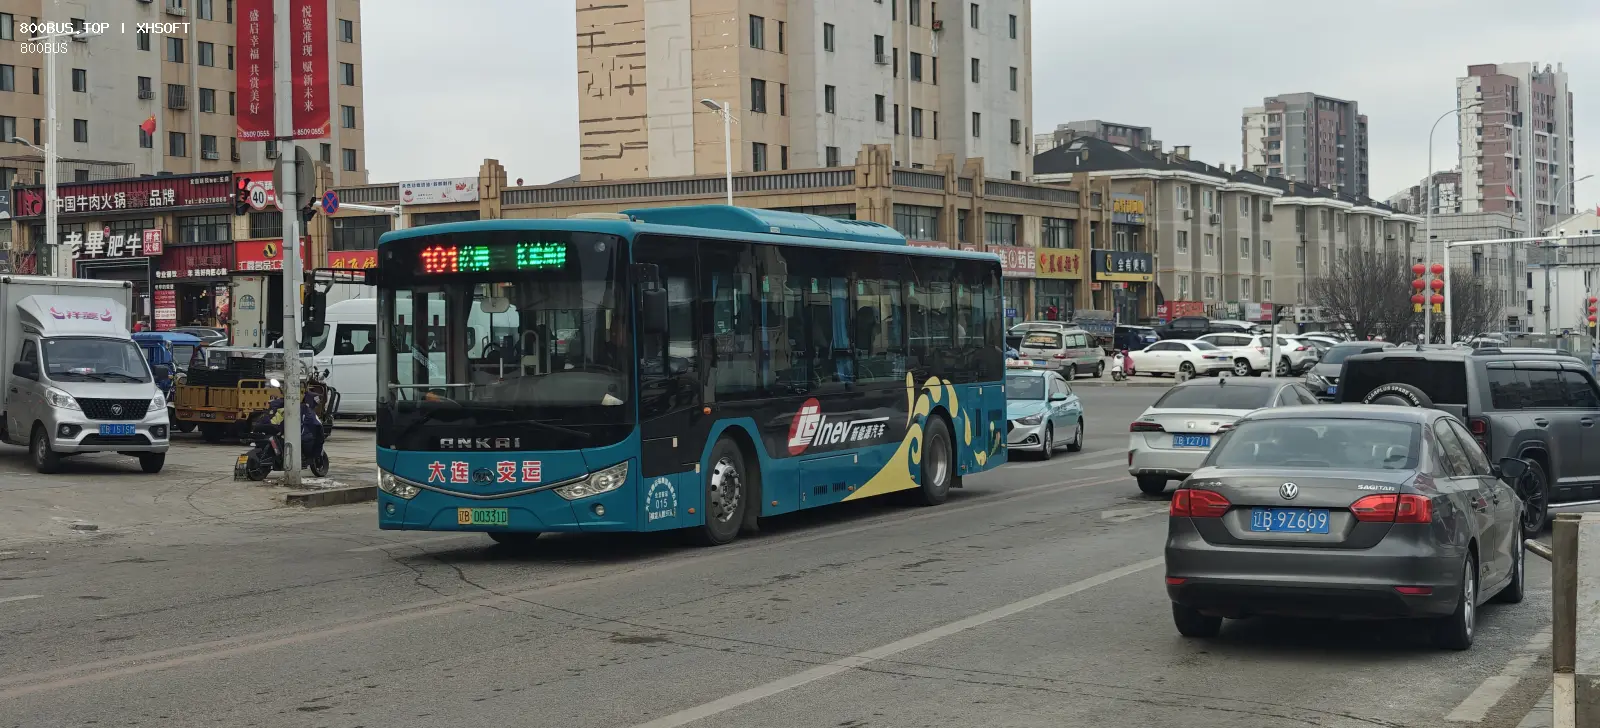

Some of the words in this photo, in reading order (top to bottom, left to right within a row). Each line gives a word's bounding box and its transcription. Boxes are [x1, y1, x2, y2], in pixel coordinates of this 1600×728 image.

[249, 9, 260, 60] 盛启幸福
[302, 5, 313, 57] 悦鉴准现
[249, 64, 260, 115] 共赏美好
[302, 61, 314, 112] 赋新未来
[56, 192, 126, 213] 中国牛肉火锅
[149, 188, 175, 208] 品牌
[252, 191, 265, 204] 40
[422, 246, 458, 272] 101
[1367, 385, 1390, 400] CARPLUS
[1391, 385, 1410, 396] SPARE
[1409, 392, 1420, 406] TIRE
[440, 437, 520, 448] ANKAI
[850, 423, 886, 442] 新能源汽车
[428, 461, 469, 484] 大连
[497, 461, 541, 483] 交运
[1357, 484, 1396, 492] SAGITAR
[655, 499, 668, 509] 015
